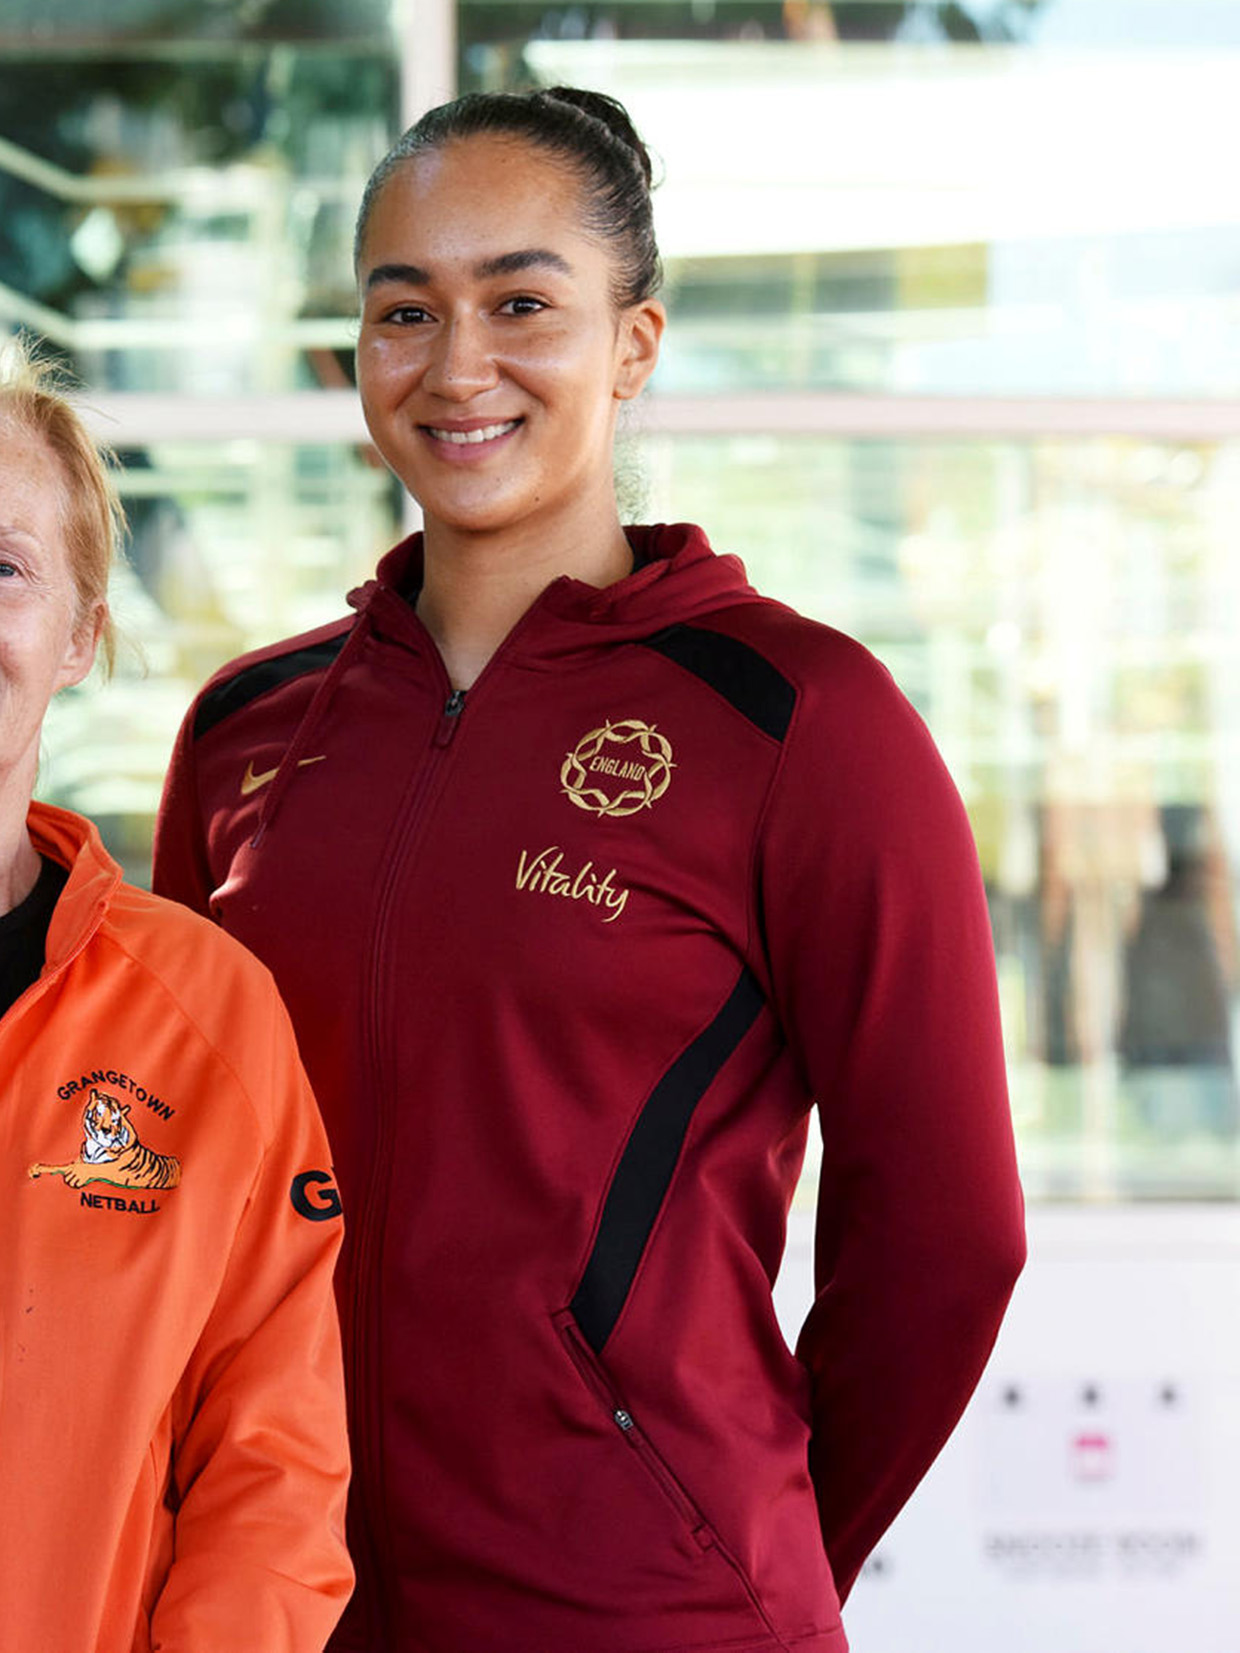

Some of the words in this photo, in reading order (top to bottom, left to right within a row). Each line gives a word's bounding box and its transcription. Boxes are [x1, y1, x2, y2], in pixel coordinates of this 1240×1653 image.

[589, 756, 646, 781] ENGLAND
[516, 846, 629, 922] Vitality
[57, 1070, 175, 1121] GRANGETOWN
[80, 1192, 160, 1214] NETBALL
